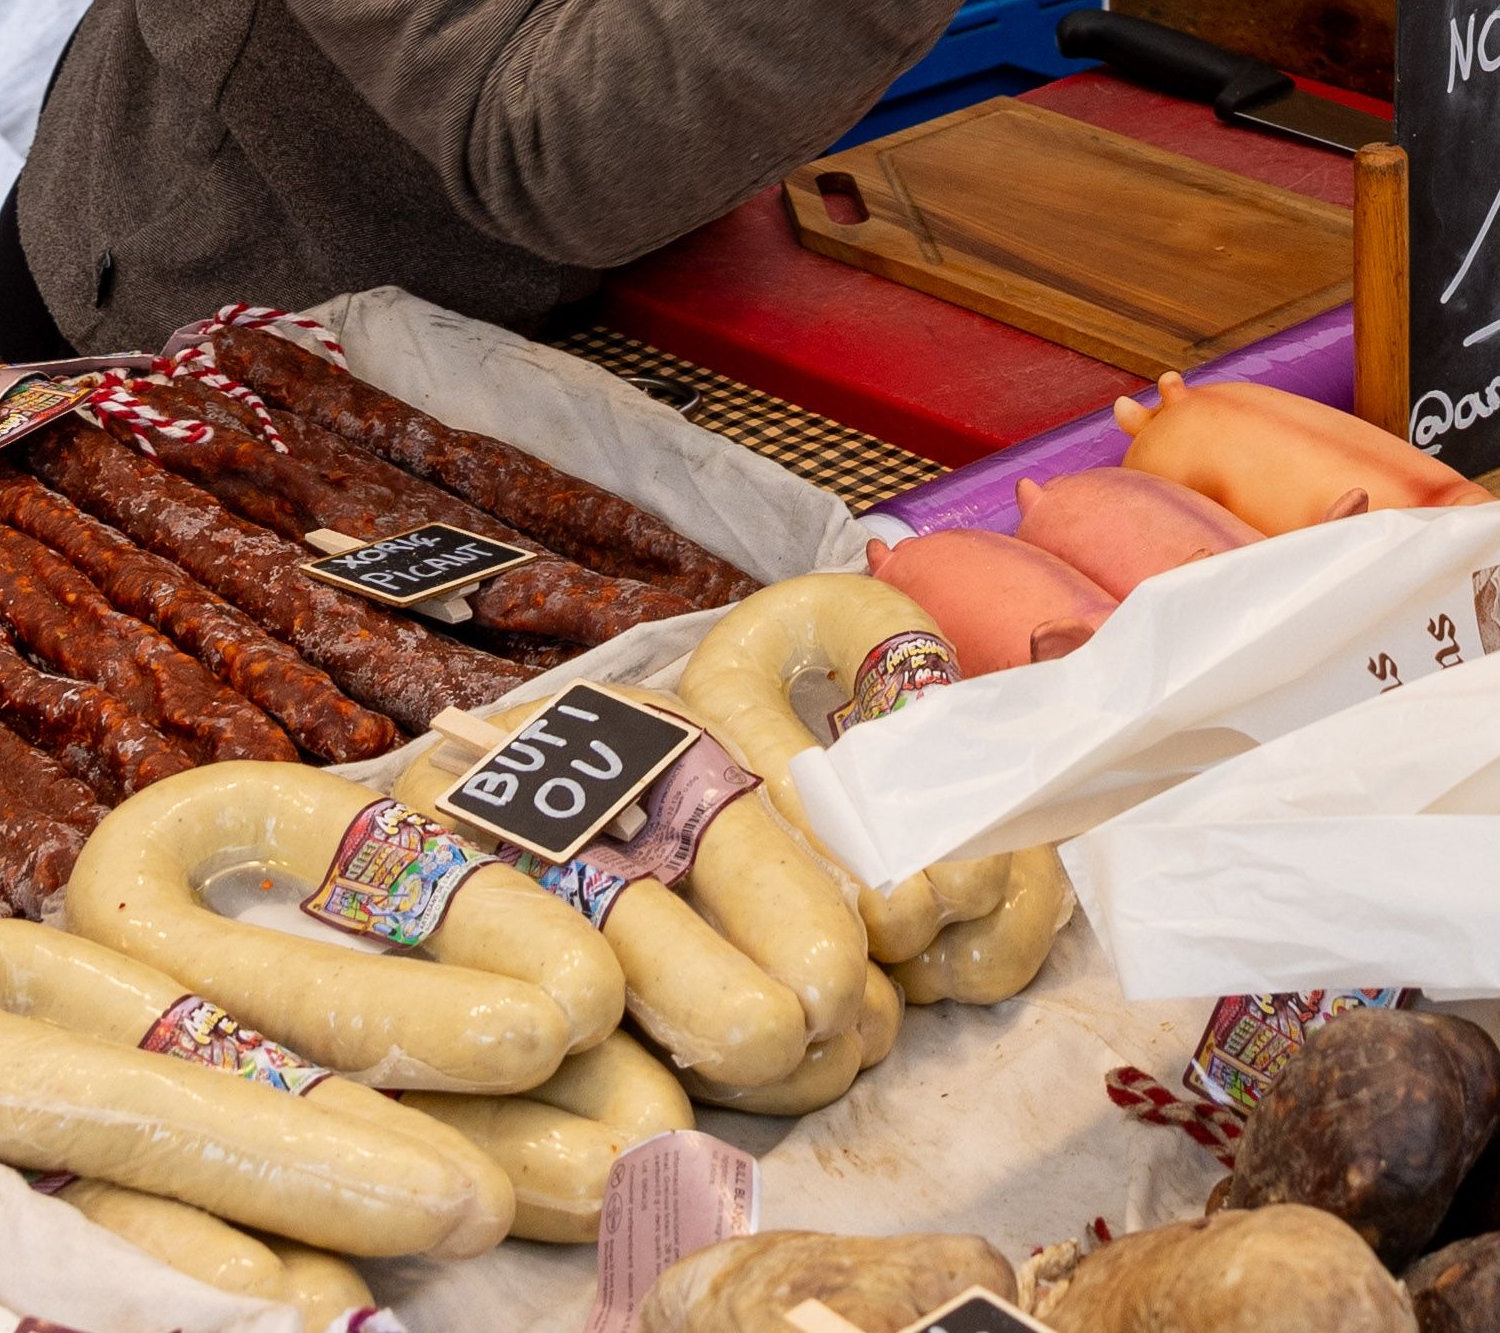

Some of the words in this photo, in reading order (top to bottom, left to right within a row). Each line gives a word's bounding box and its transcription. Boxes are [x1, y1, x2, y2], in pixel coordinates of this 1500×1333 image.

[886, 637, 950, 674] ARTESANS
[910, 654, 927, 669] DE
[533, 739, 623, 819] OU
